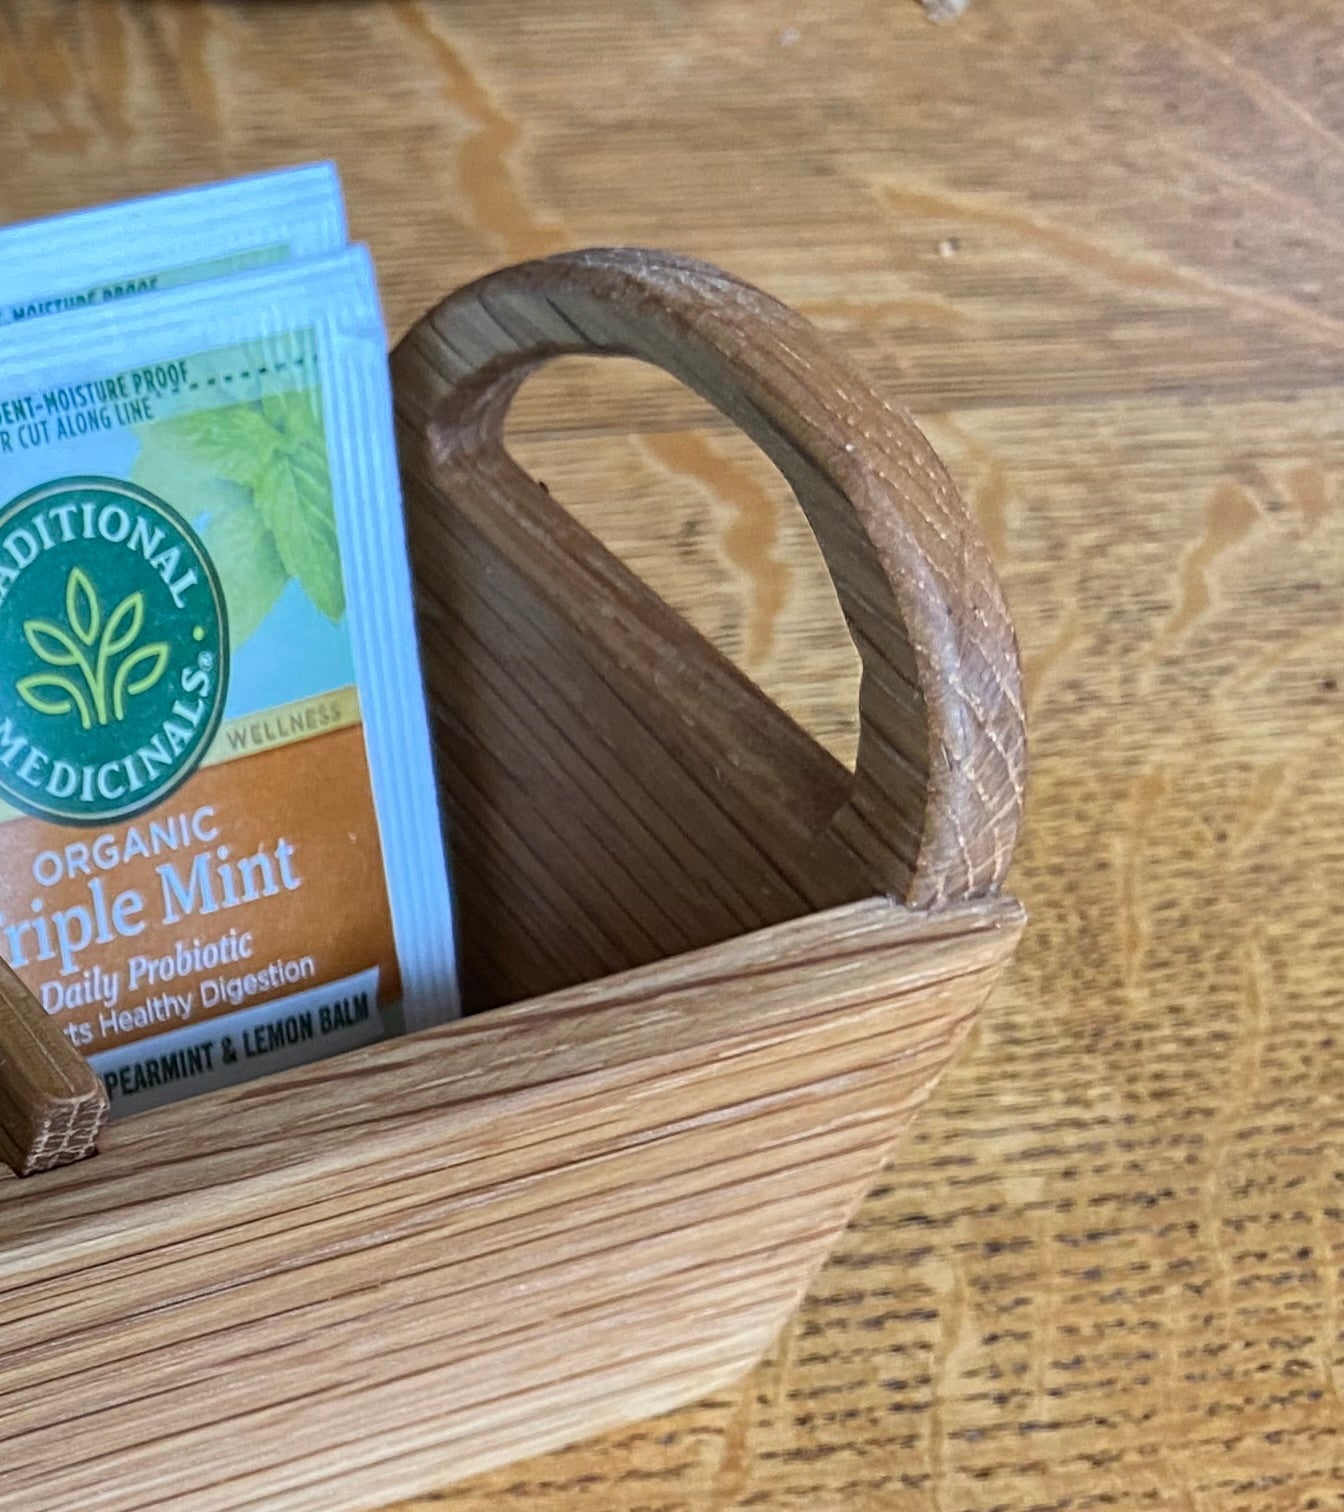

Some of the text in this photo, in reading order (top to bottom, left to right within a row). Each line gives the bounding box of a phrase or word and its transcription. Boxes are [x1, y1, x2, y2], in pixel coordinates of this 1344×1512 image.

[132, 359, 190, 393] PROOF
[17, 422, 52, 450] CUT
[56, 409, 113, 444] ALONG
[117, 397, 155, 427] LINE
[227, 703, 342, 751] WELLNESS
[32, 805, 221, 887] ORGANIC
[155, 837, 303, 927] Mint
[39, 927, 253, 1016] Daily Probiotic
[99, 990, 193, 1037] Healthy
[201, 955, 316, 1010] Digestion
[102, 991, 369, 1098] PEARMINT & LEMON BALM
